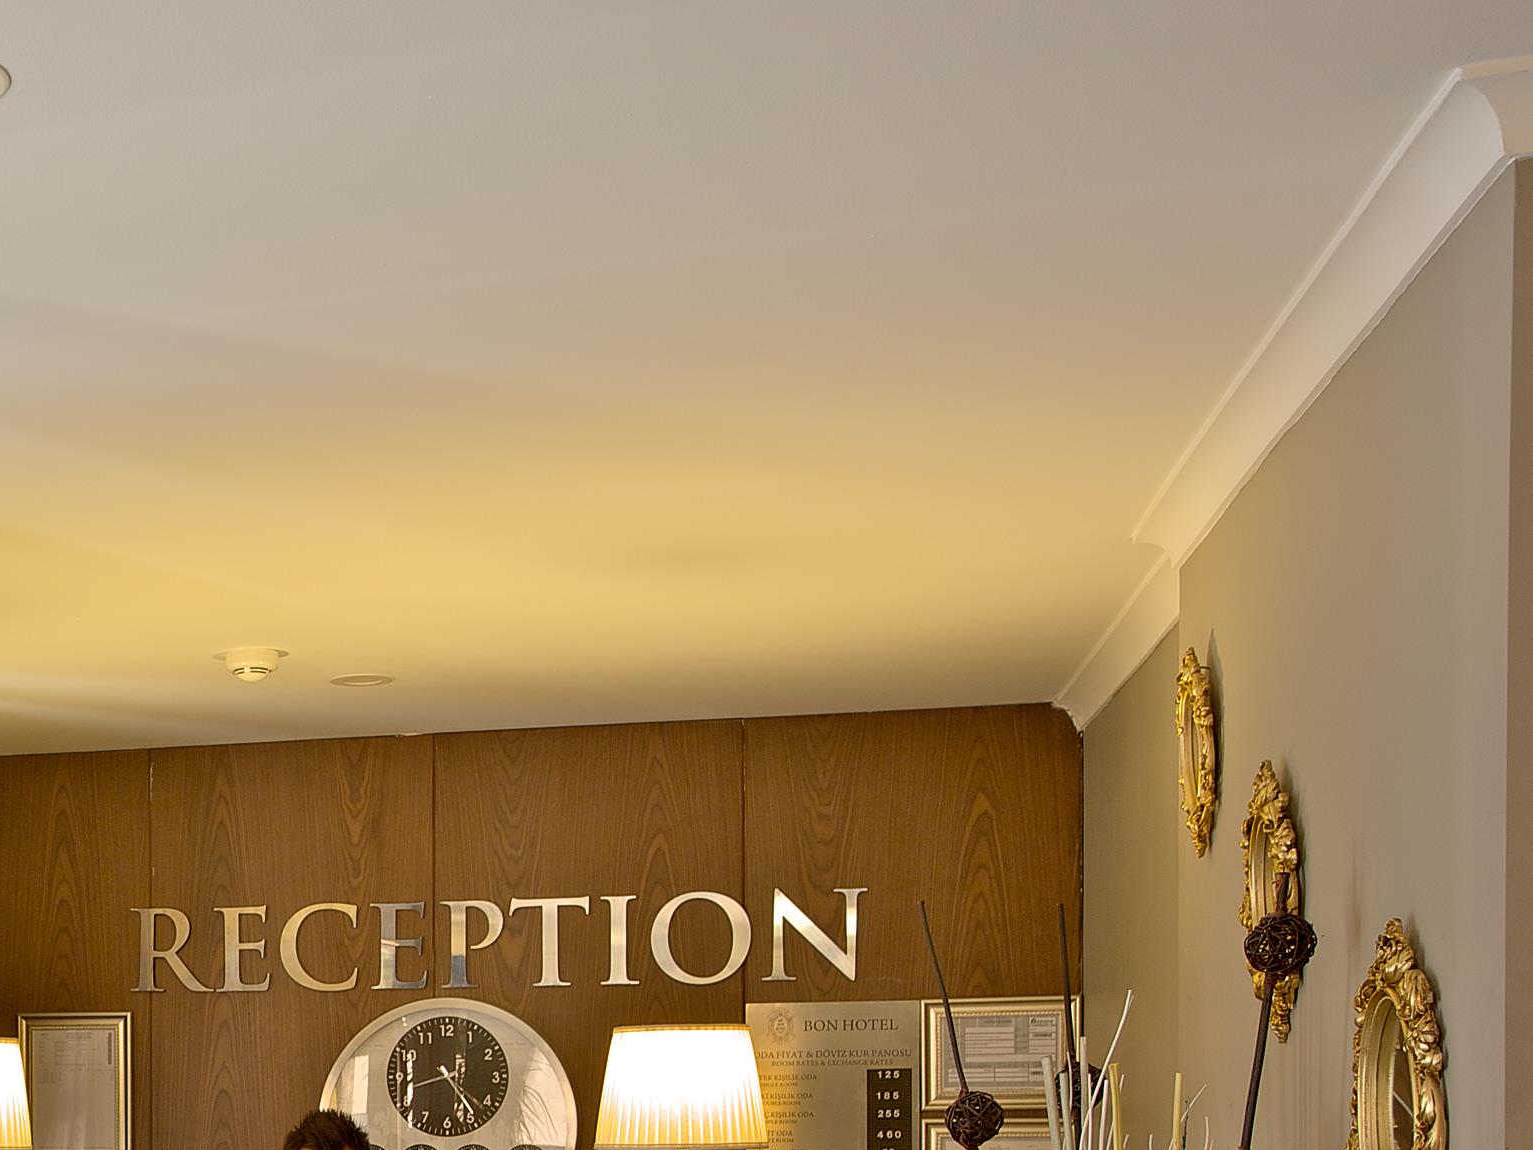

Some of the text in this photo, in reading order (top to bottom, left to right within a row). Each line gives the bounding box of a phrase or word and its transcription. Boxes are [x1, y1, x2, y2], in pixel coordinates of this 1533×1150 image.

[130, 887, 869, 992] RECEPTION
[440, 1025, 454, 1036] 12
[804, 1018, 899, 1032] BON HOTEL
[418, 1033, 432, 1044] 11
[467, 1031, 472, 1043] 1
[484, 1049, 492, 1060] 2
[871, 1049, 912, 1057] PANOSU
[396, 1072, 403, 1082] 9
[492, 1072, 500, 1083] 3
[878, 1070, 900, 1079] 125
[483, 1095, 491, 1106] 4
[876, 1091, 900, 1100] 185
[422, 1112, 429, 1122] 7
[467, 1113, 474, 1123] 5
[878, 1109, 900, 1118] 255
[443, 1117, 451, 1128] 6
[877, 1130, 902, 1139] 460
